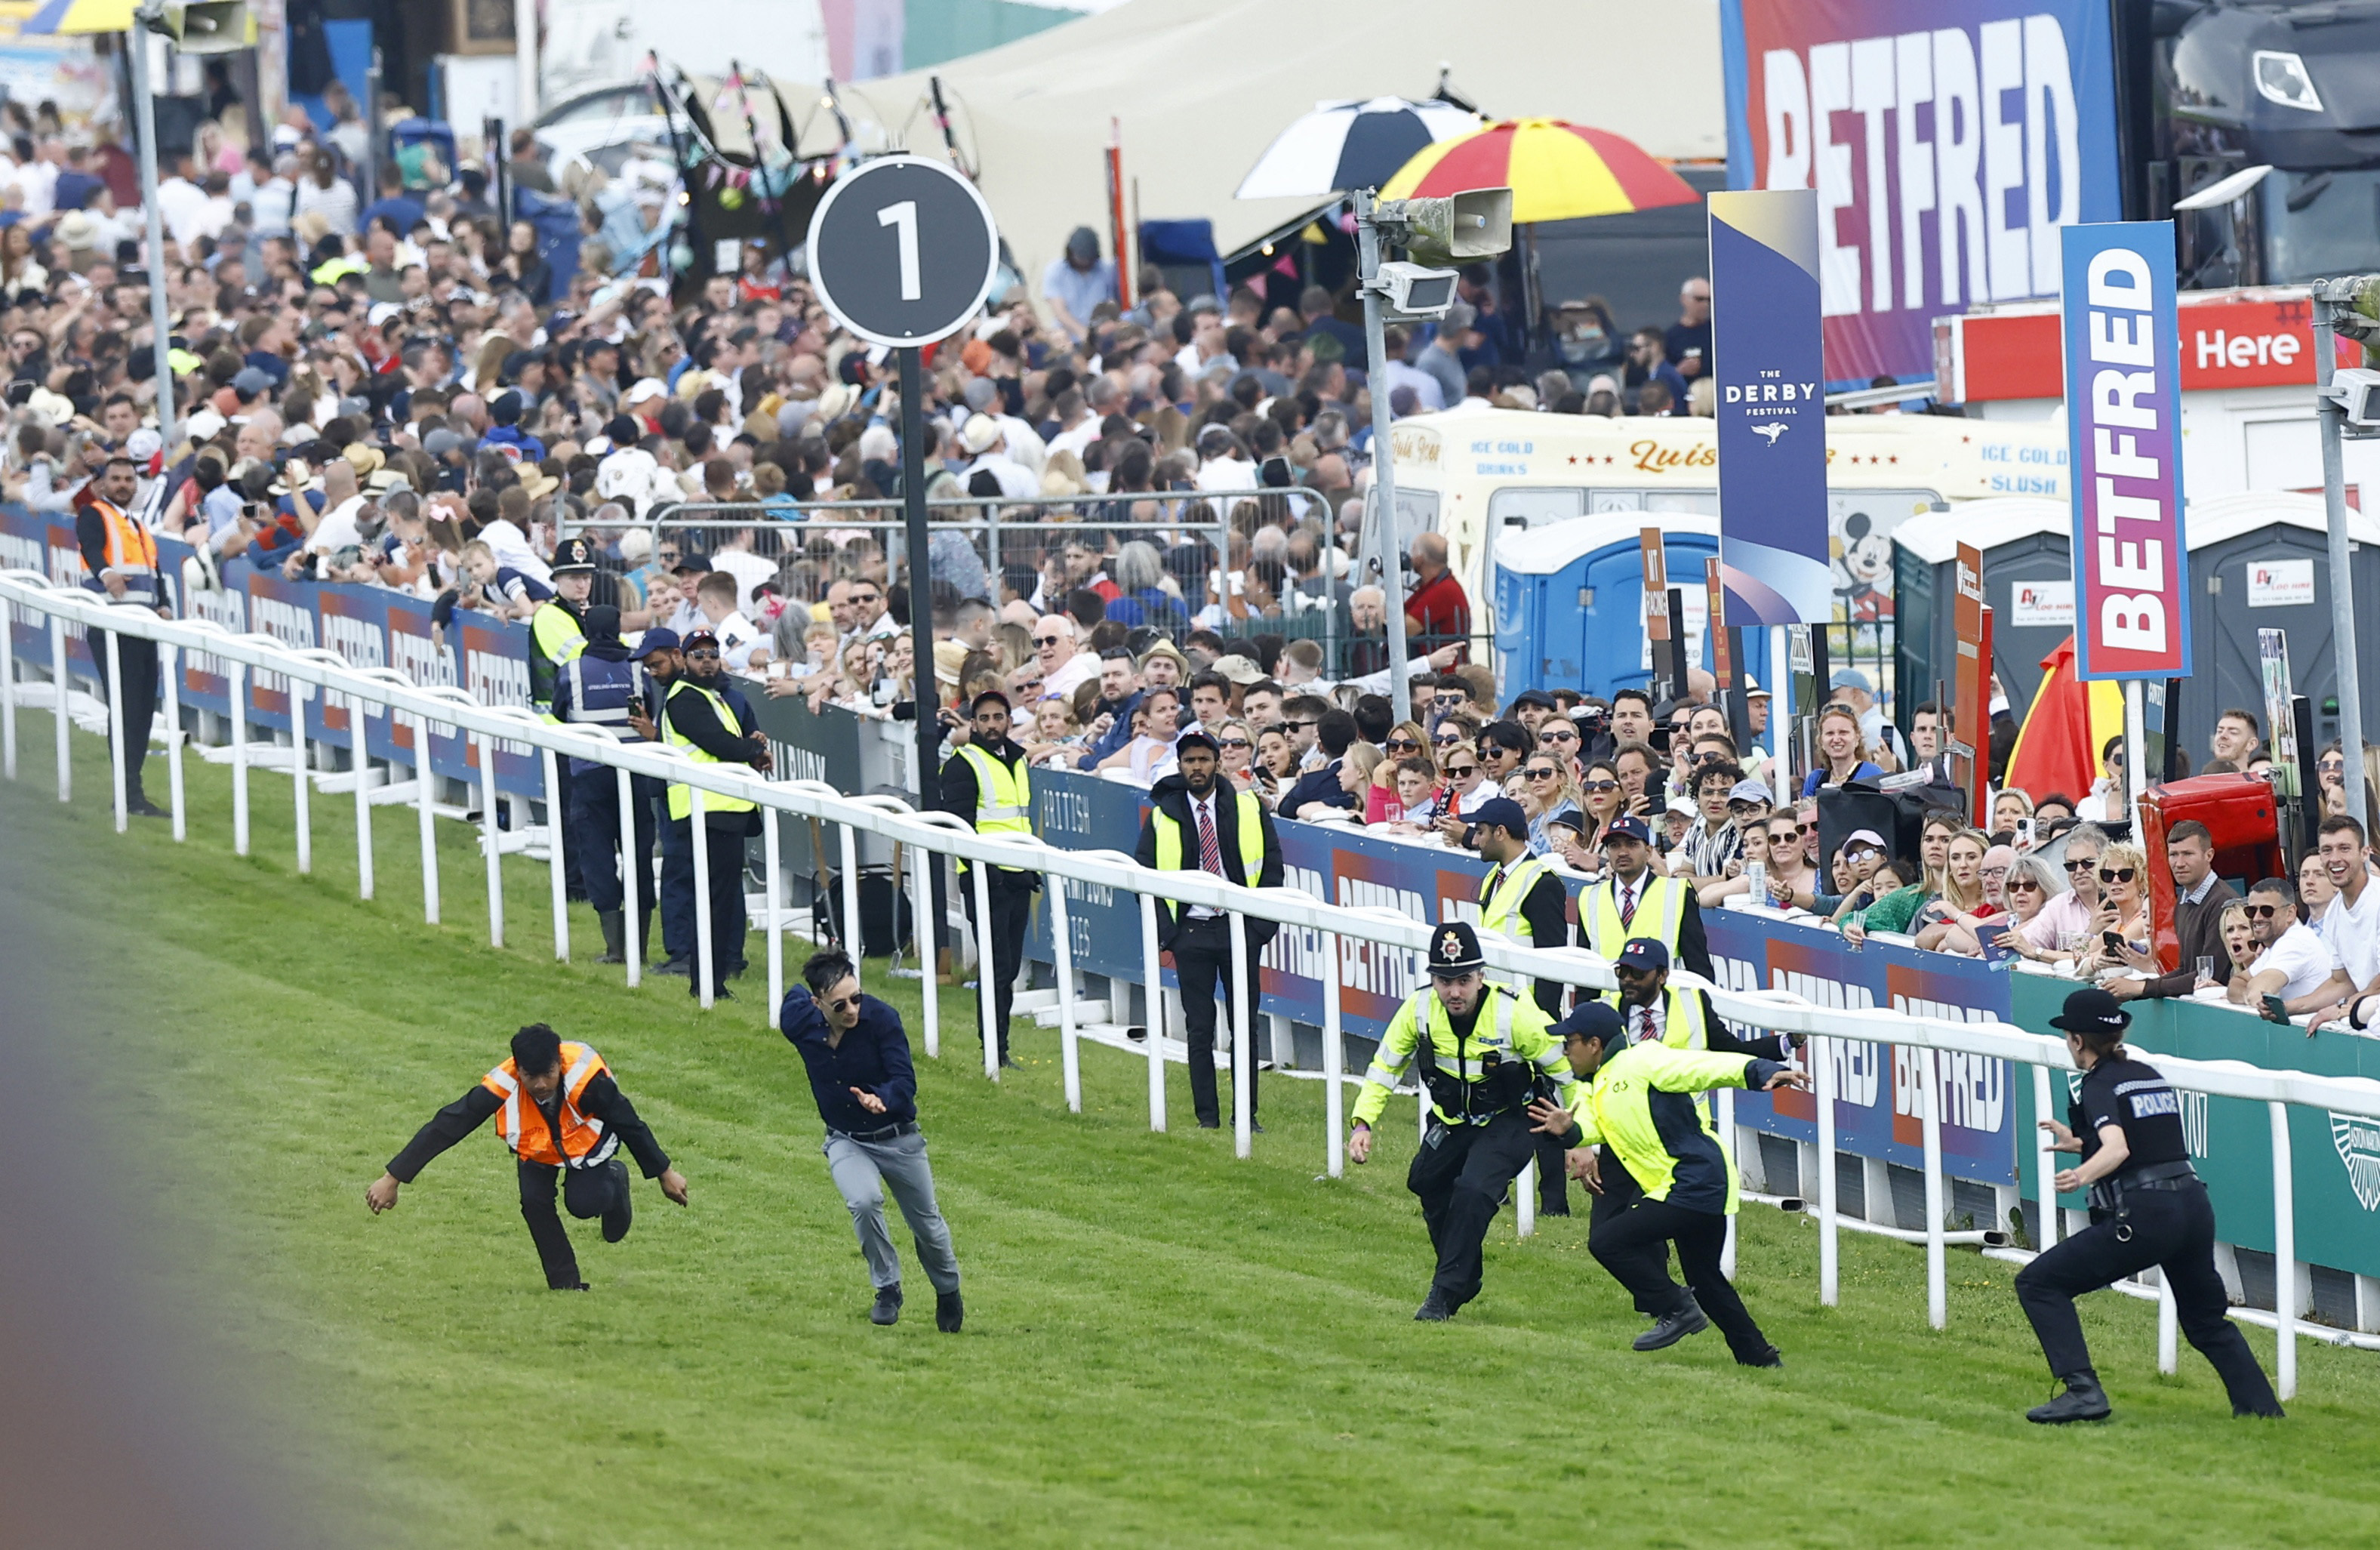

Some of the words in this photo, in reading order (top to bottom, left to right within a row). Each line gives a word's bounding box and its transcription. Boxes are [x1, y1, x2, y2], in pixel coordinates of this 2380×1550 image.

[1764, 14, 2081, 318] BETFRED
[876, 200, 921, 300] 1
[2196, 328, 2301, 369] Here
[1760, 370, 1781, 378] THE
[1726, 383, 1815, 403] DERBY
[1746, 407, 1798, 416] FESTIVAL
[1981, 445, 2012, 462] ICE
[2019, 448, 2067, 466] COLD
[2087, 248, 2167, 653] BETFRED
[1991, 474, 2057, 495] SLUSH
[1042, 788, 1091, 835] BRITISH
[2134, 1092, 2178, 1118] POLICE
